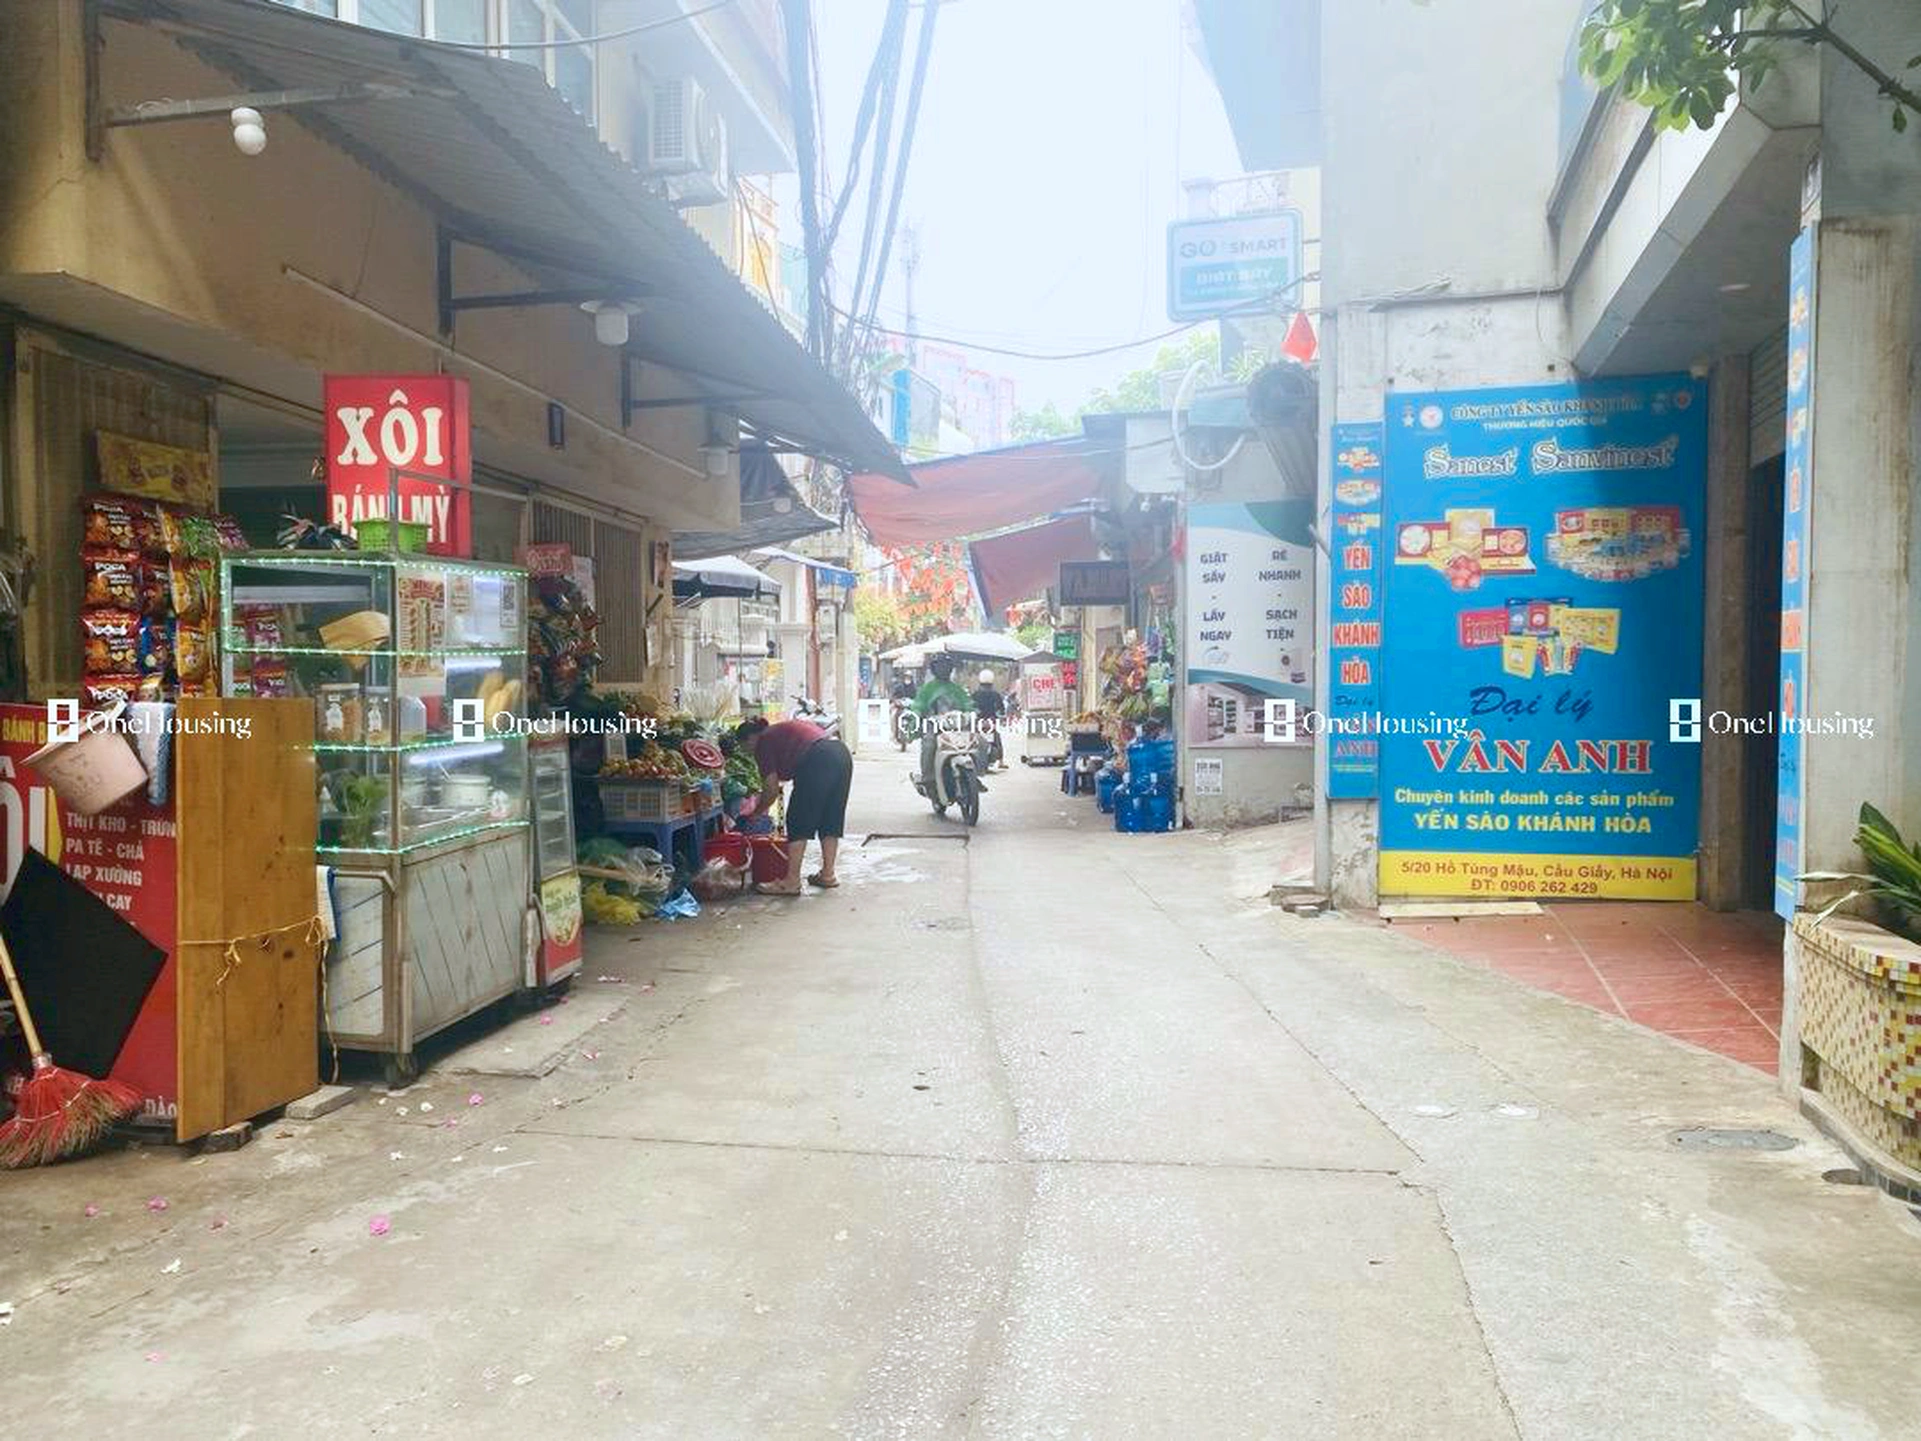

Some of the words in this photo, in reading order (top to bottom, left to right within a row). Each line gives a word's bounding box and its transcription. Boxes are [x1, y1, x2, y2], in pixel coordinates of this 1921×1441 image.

[337, 389, 443, 466] XÔI
[1423, 442, 1518, 479] Sanest
[411, 485, 450, 543] MỲ
[1470, 686, 1542, 723] Đại
[1556, 687, 1595, 723] lý
[1423, 729, 1531, 773] VÂN
[1538, 739, 1654, 774] ANH
[1395, 788, 1453, 806] Chuyên
[1459, 789, 1494, 804] kinh
[1499, 789, 1549, 805] doanh
[1555, 790, 1584, 805] các
[98, 815, 126, 832] KHO
[1413, 808, 1459, 830] YẾN
[1465, 810, 1510, 831] SÀO
[1517, 811, 1596, 832] KHÁNH
[1604, 812, 1652, 833] HÒA
[66, 837, 84, 854] PA
[1401, 861, 1431, 874] 5/20
[1436, 859, 1456, 874] Hồ
[1461, 861, 1498, 878] Tùng
[1621, 866, 1642, 880] Hà
[1646, 867, 1674, 883] Nội
[1470, 878, 1495, 891] ĐT:
[1500, 879, 1536, 893] 0906
[1540, 880, 1567, 893] 262
[1570, 881, 1599, 894] 429
